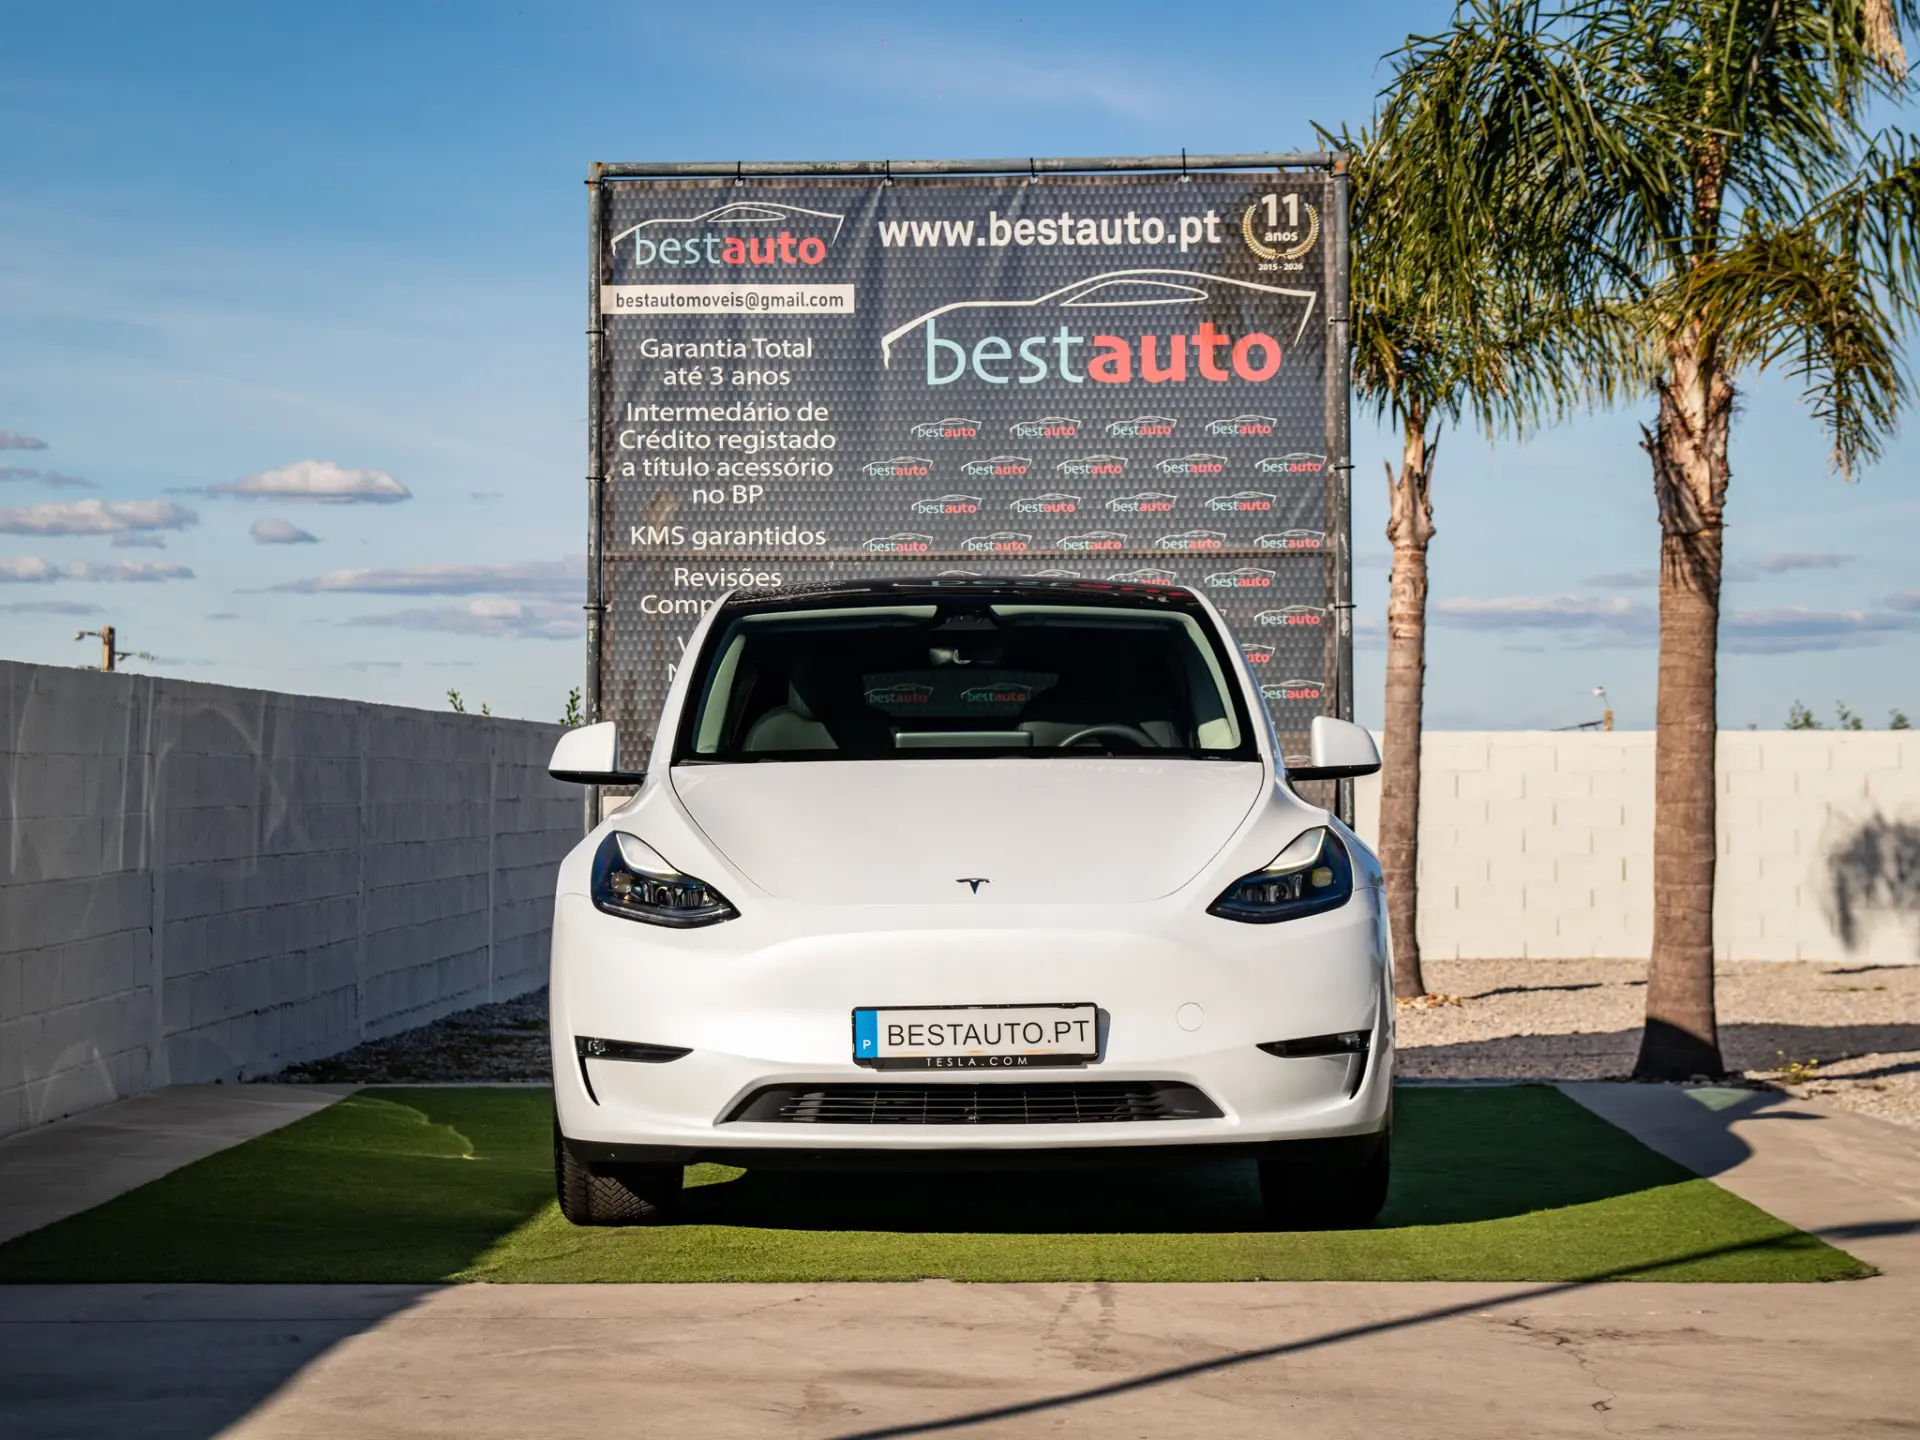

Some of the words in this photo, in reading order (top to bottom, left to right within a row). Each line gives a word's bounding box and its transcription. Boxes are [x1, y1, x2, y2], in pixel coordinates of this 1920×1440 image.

[1261, 193, 1298, 226] 11
[878, 210, 1221, 252] www.bestauto.pt
[1264, 231, 1298, 242] anos
[635, 228, 826, 265] bestauto
[1258, 263, 1278, 271] 2015
[1283, 263, 1304, 271] 2026
[616, 292, 844, 310] bestautomoveis@gmail.com
[640, 338, 747, 358] Garantia
[752, 338, 812, 358] Total
[927, 319, 1282, 385] bestauto
[663, 365, 702, 386] até
[709, 367, 724, 385] 3
[731, 371, 790, 386] anos
[626, 402, 790, 421] Intermedário
[798, 402, 829, 421] de
[918, 426, 976, 438] bestauto
[1017, 424, 1075, 437] bestauto
[1113, 423, 1171, 435] bestauto
[1213, 422, 1271, 435] bestauto
[619, 429, 711, 450] Crédito
[718, 429, 837, 453] registado
[622, 461, 635, 476] a
[642, 457, 709, 476] título
[715, 457, 833, 476] acessório
[869, 464, 927, 476] bestauto
[969, 464, 1027, 475] bestauto
[1064, 463, 1122, 475] bestauto
[1164, 462, 1222, 473] bestauto
[1263, 460, 1321, 473] bestauto
[692, 488, 724, 503] no
[733, 485, 763, 503] BP
[918, 502, 976, 514] bestauto
[1017, 501, 1075, 513] bestauto
[1113, 499, 1171, 512] bestauto
[1212, 499, 1270, 511] bestauto
[631, 526, 684, 545] KMS
[692, 526, 826, 549] garantidos
[1262, 537, 1320, 549] bestauto
[869, 540, 927, 552] bestauto
[969, 539, 1027, 551] bestauto
[1064, 538, 1122, 550] bestauto
[1163, 538, 1221, 550] bestauto
[674, 567, 782, 587] Revisões
[1212, 575, 1270, 587] bestauto
[1262, 613, 1320, 625] bestauto
[888, 1020, 1090, 1047] BESTAUTO.PT
[863, 1040, 871, 1049] P
[926, 1057, 1028, 1067] TESLA.COM
